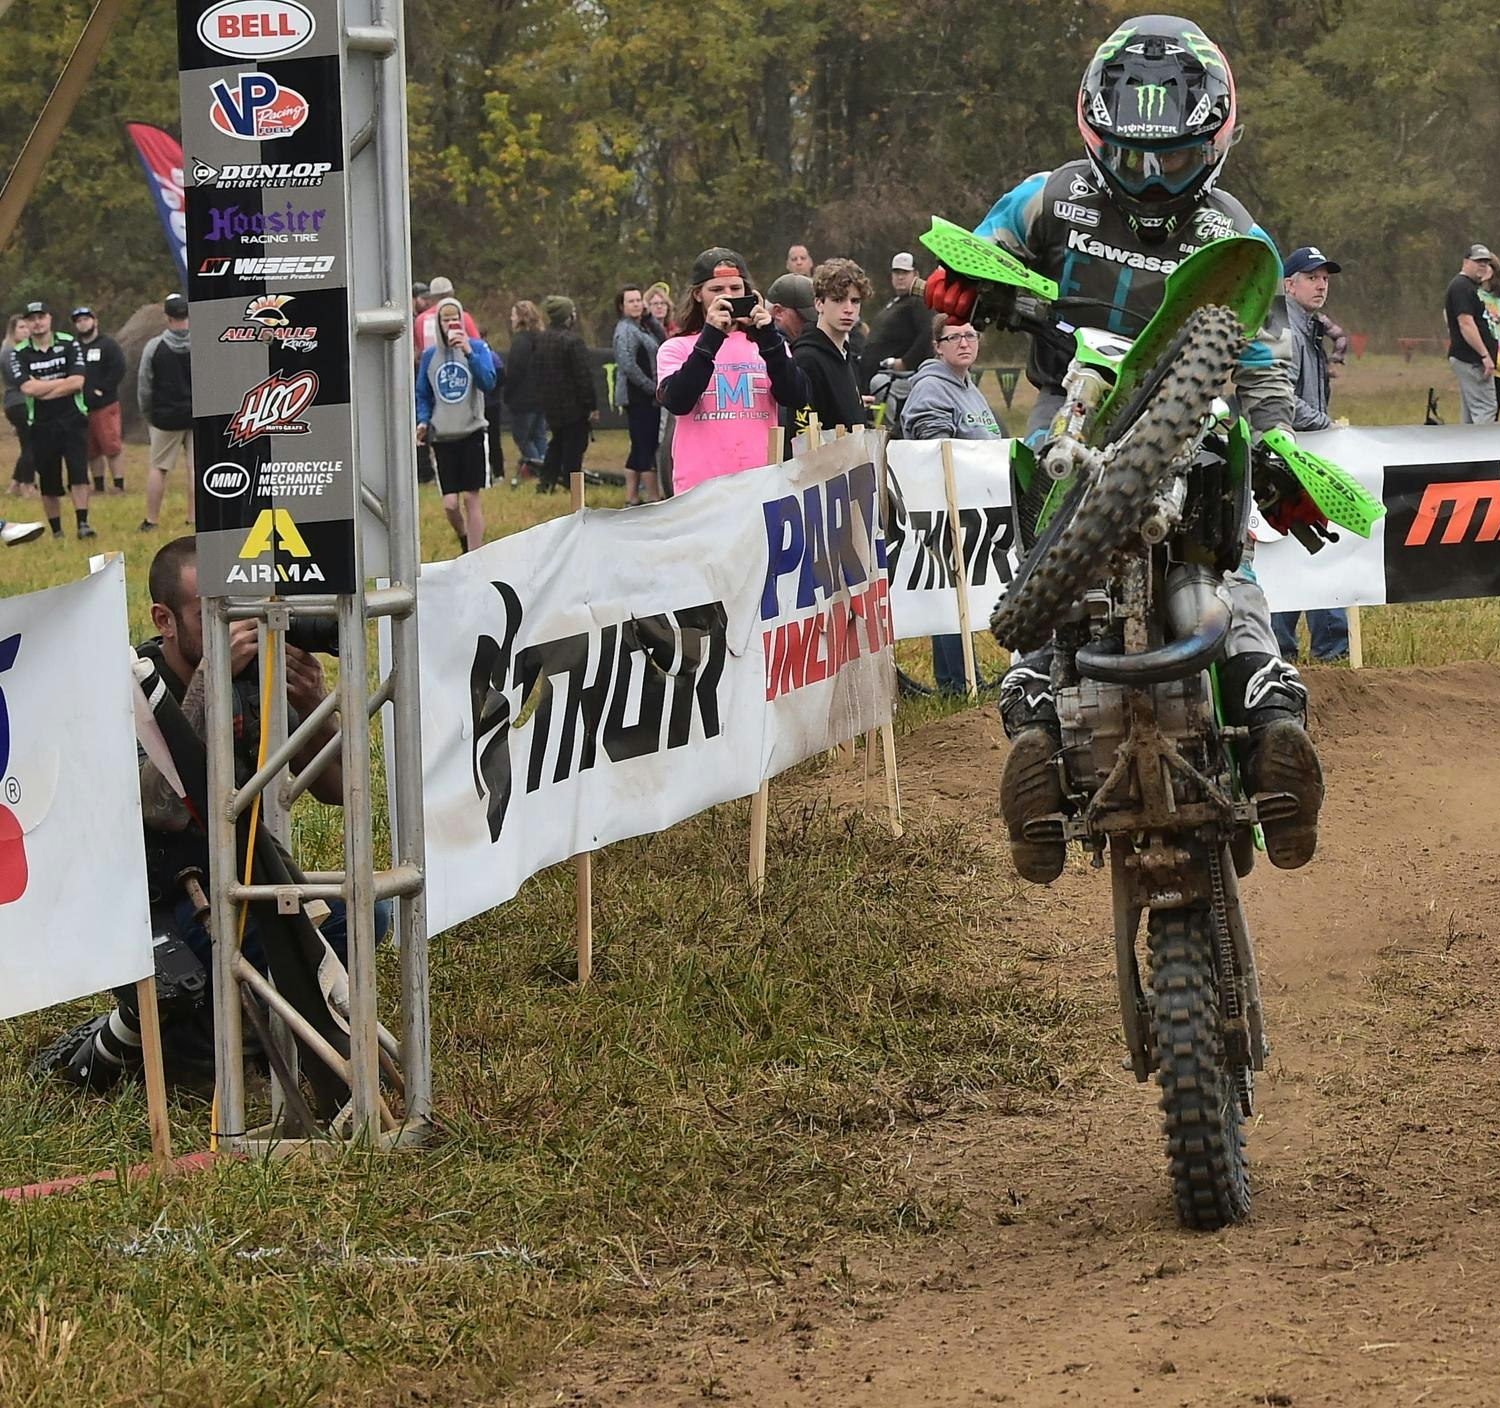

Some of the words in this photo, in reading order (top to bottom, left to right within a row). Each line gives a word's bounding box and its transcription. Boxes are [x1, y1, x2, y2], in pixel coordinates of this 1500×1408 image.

[217, 13, 296, 38] BELL
[212, 74, 277, 137] VP
[258, 105, 309, 127] Racing
[259, 126, 291, 134] FUELS
[1116, 123, 1178, 134] MONSTER
[218, 162, 332, 180] DUNLOP
[215, 179, 286, 189] MOTORCYCLE
[291, 178, 322, 187] TIRES
[203, 201, 326, 240] Hoosier
[1054, 201, 1101, 227] WPS
[1195, 207, 1233, 229] TEAM
[240, 233, 289, 244] RACING
[292, 233, 319, 242] TIRE
[1067, 229, 1184, 275] Kawasa
[220, 328, 256, 341] ALL
[281, 338, 318, 352] Racing
[694, 412, 736, 420] RACING
[260, 461, 343, 473] MOTORCYCLE
[210, 472, 243, 488] MMI
[258, 473, 334, 485] MECHANICS
[256, 485, 324, 496] INSTITUTE
[226, 563, 326, 583] ARMA
[512, 601, 728, 794] THOR
